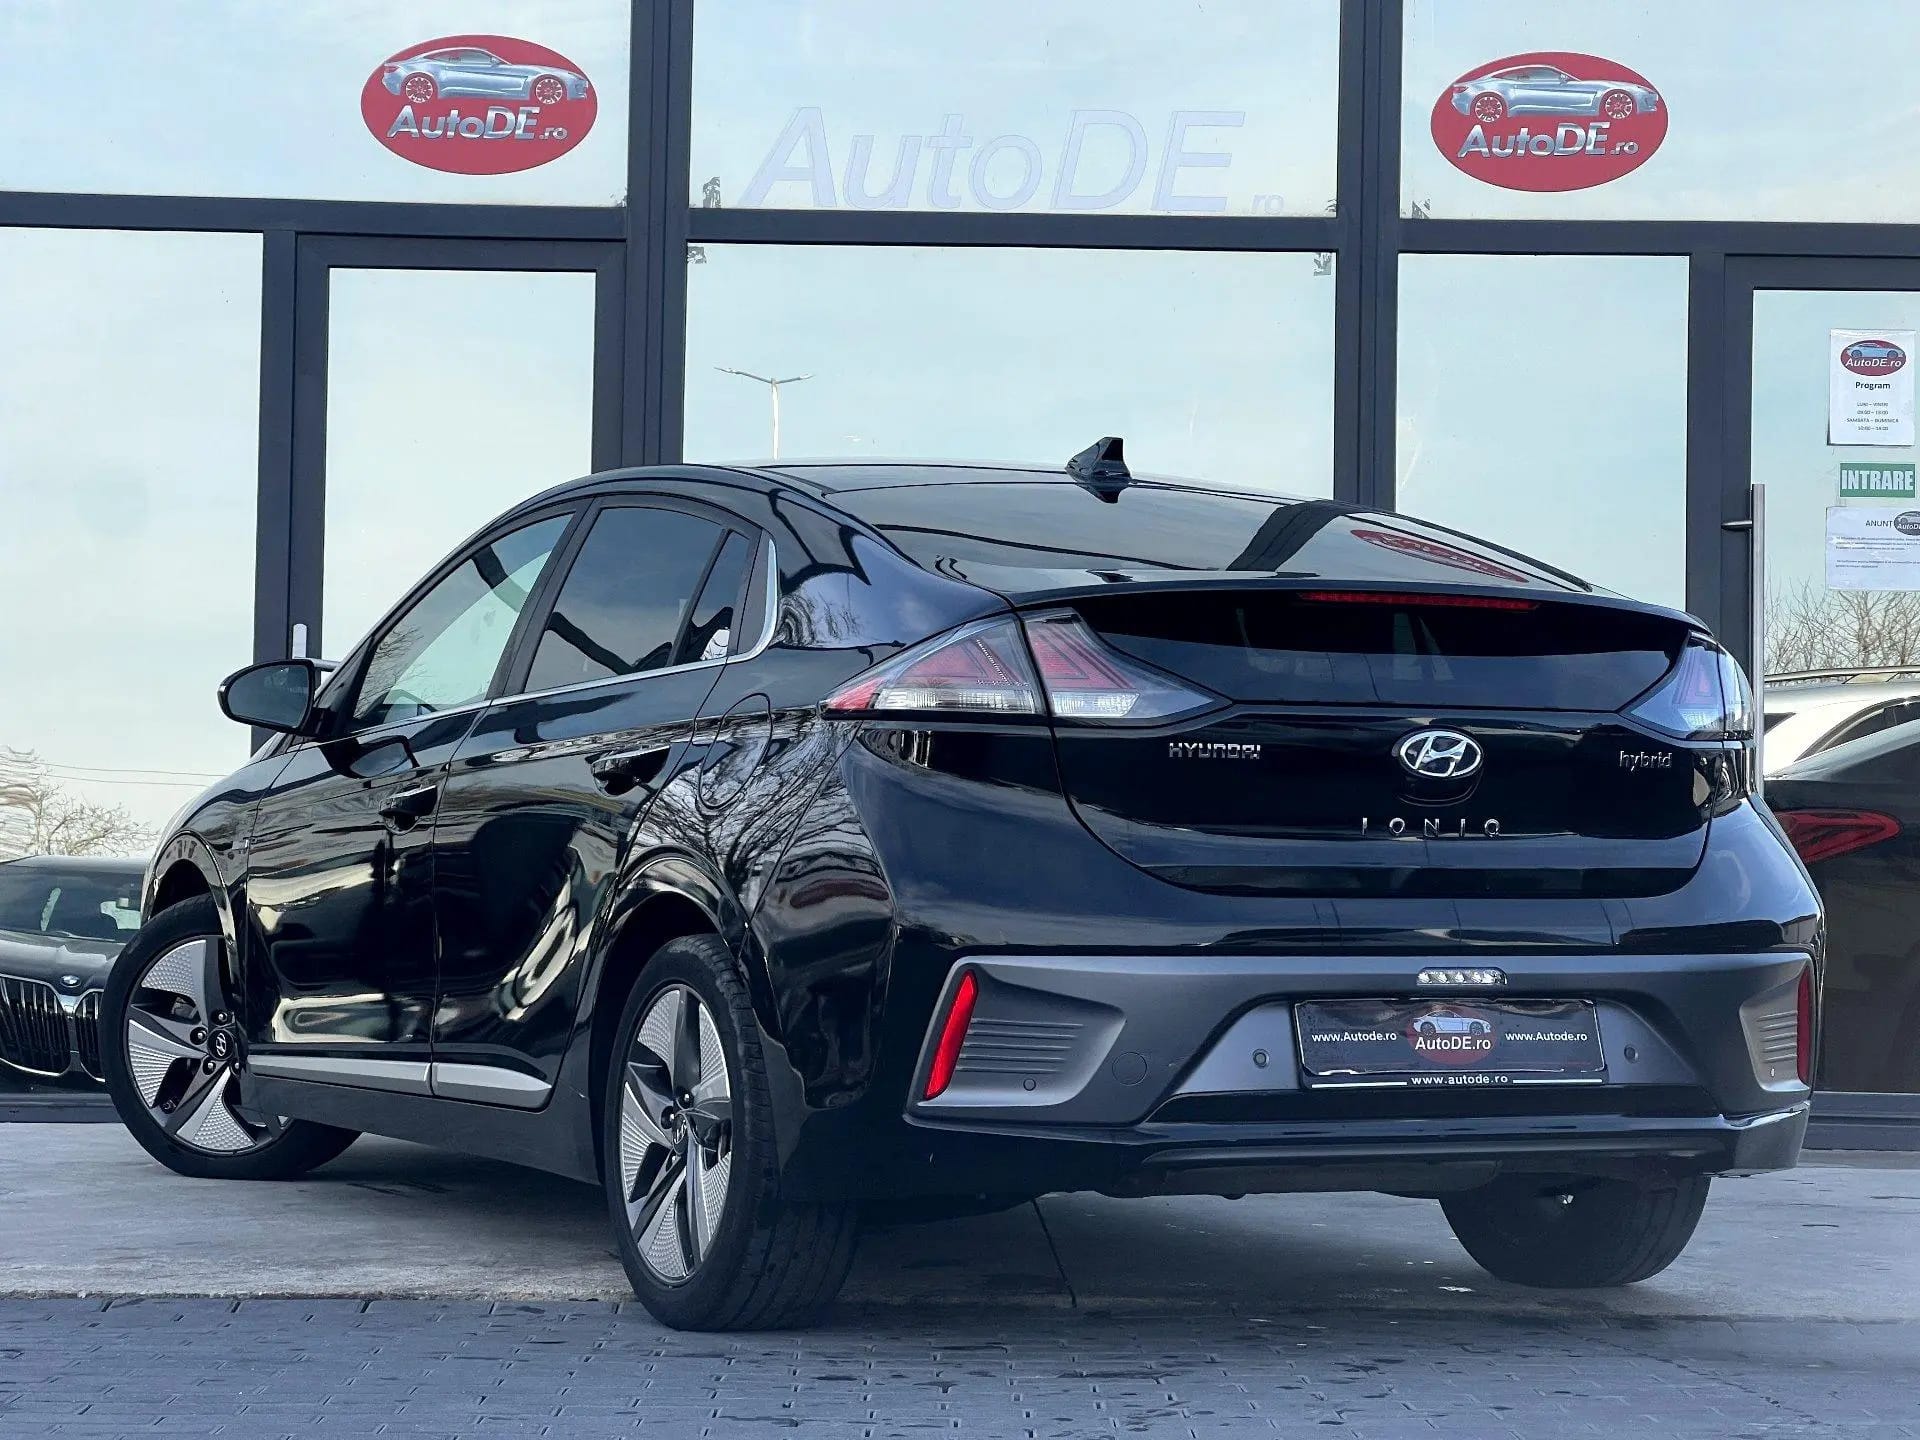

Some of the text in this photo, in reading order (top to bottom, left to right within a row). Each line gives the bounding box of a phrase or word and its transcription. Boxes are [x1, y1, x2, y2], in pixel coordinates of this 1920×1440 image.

[1845, 358, 1902, 368] AutoDE.ro
[1855, 381, 1891, 390] Program
[1841, 469, 1914, 491] INTRARE
[1169, 742, 1261, 760] HYUNDAI
[1619, 745, 1673, 773] hybrid
[1362, 817, 1500, 838] IONIQ
[1311, 1031, 1398, 1042] www.Autode.ro
[1505, 1031, 1588, 1042] www.Autode.ro
[1415, 1036, 1492, 1051] AutoDE.ro
[1411, 1073, 1508, 1085] www.autode.ro
